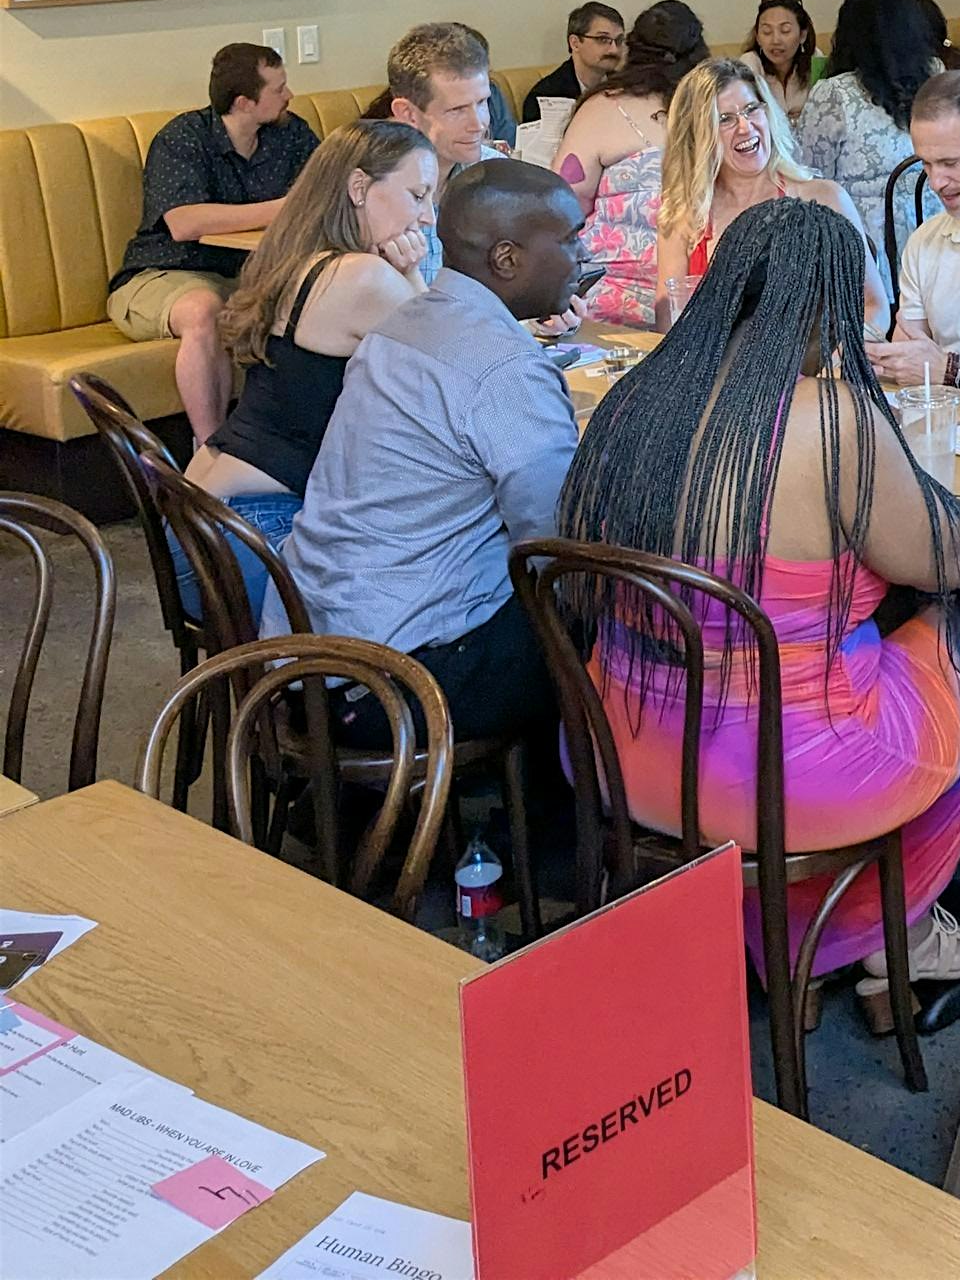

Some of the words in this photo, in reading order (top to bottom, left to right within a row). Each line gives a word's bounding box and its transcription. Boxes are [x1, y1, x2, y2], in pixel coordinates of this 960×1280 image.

[109, 1103, 132, 1117] MAD
[130, 1113, 152, 1127] LIBS
[155, 1122, 184, 1141] WHEN
[184, 1136, 203, 1149] YOU
[222, 1154, 235, 1163] IN
[233, 1157, 262, 1174] LOVE
[541, 1068, 693, 1181] RESERVED
[314, 1235, 385, 1267] Human
[386, 1257, 443, 1280] Bingo
